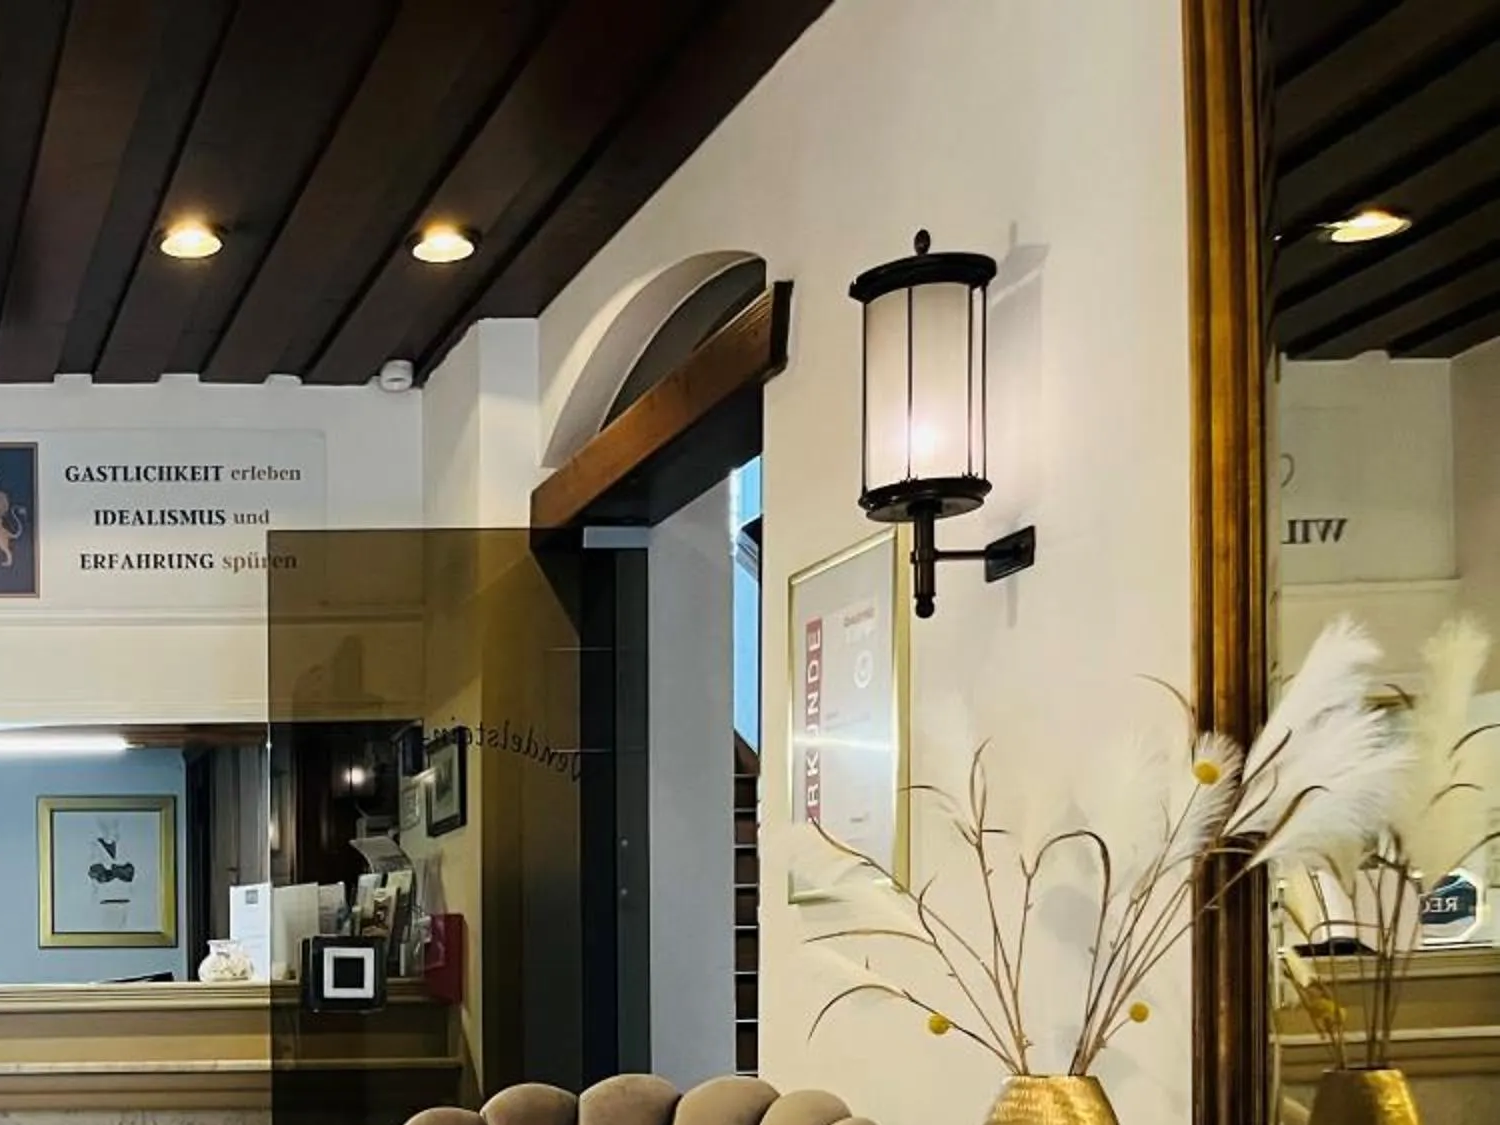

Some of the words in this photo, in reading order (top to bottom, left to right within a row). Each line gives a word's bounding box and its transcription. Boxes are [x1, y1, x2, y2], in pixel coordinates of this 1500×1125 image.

[65, 464, 224, 482] GASTLICHKEIT
[231, 465, 301, 481] erleben
[94, 508, 226, 526] IDEALISMUS
[233, 509, 270, 525] und
[80, 552, 214, 570] ERFAHRUNG
[222, 552, 298, 573] spüren
[806, 627, 821, 824] RKUNDE
